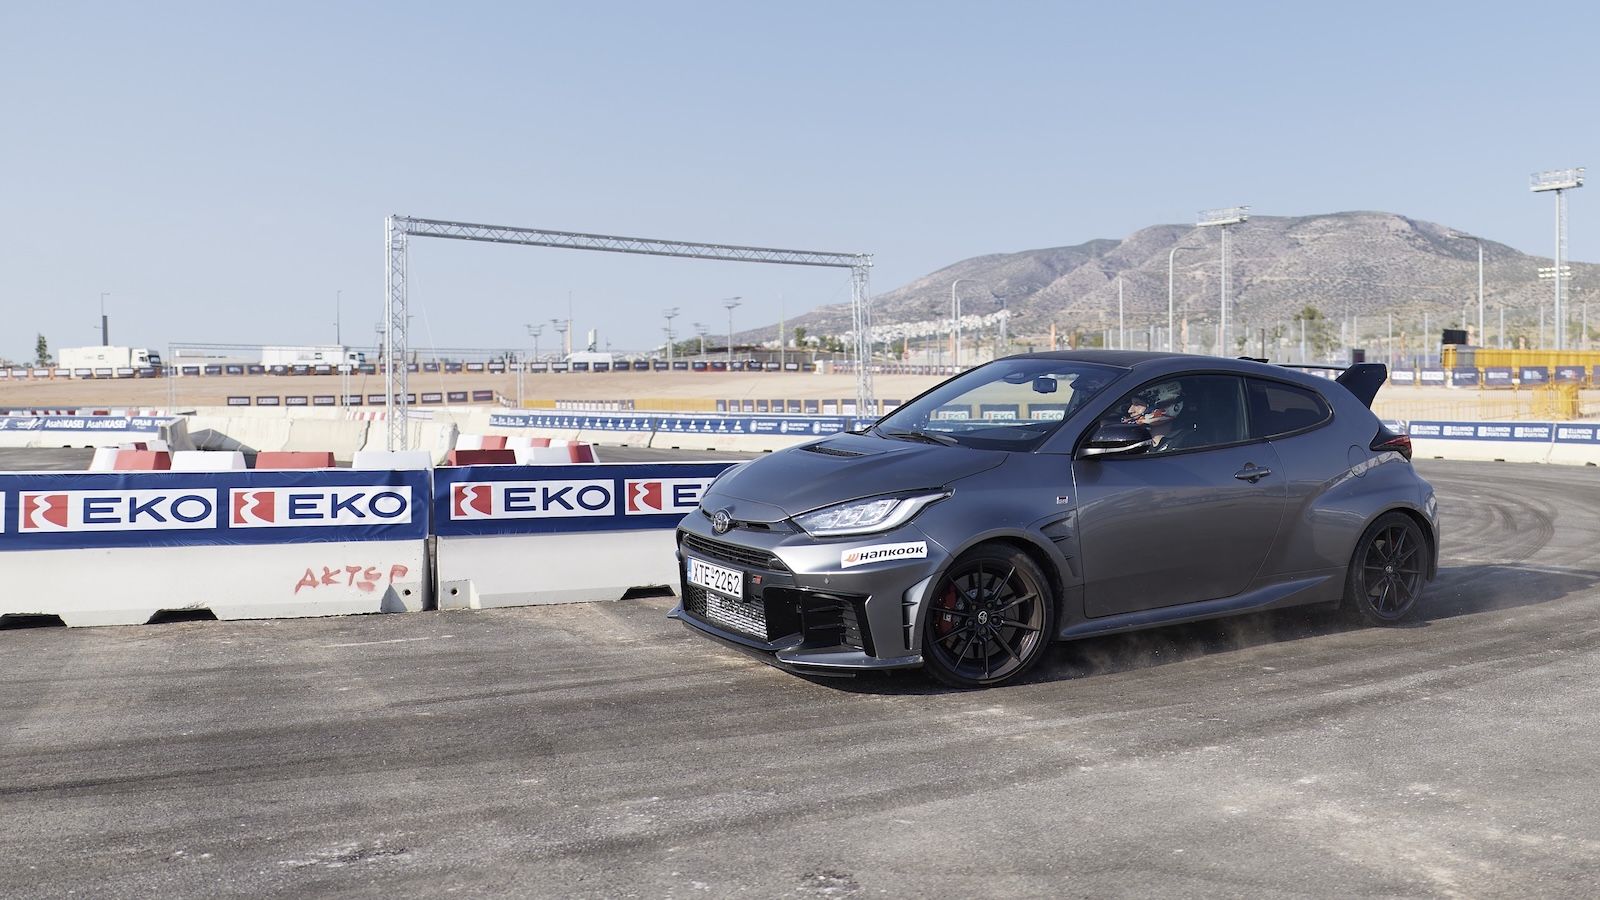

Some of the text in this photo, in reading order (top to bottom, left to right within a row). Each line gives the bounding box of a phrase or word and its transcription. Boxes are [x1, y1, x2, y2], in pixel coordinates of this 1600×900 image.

[83, 495, 213, 523] EKO
[288, 491, 408, 519] EKO
[504, 485, 611, 512] EKO
[693, 561, 740, 595] XTE-2262
